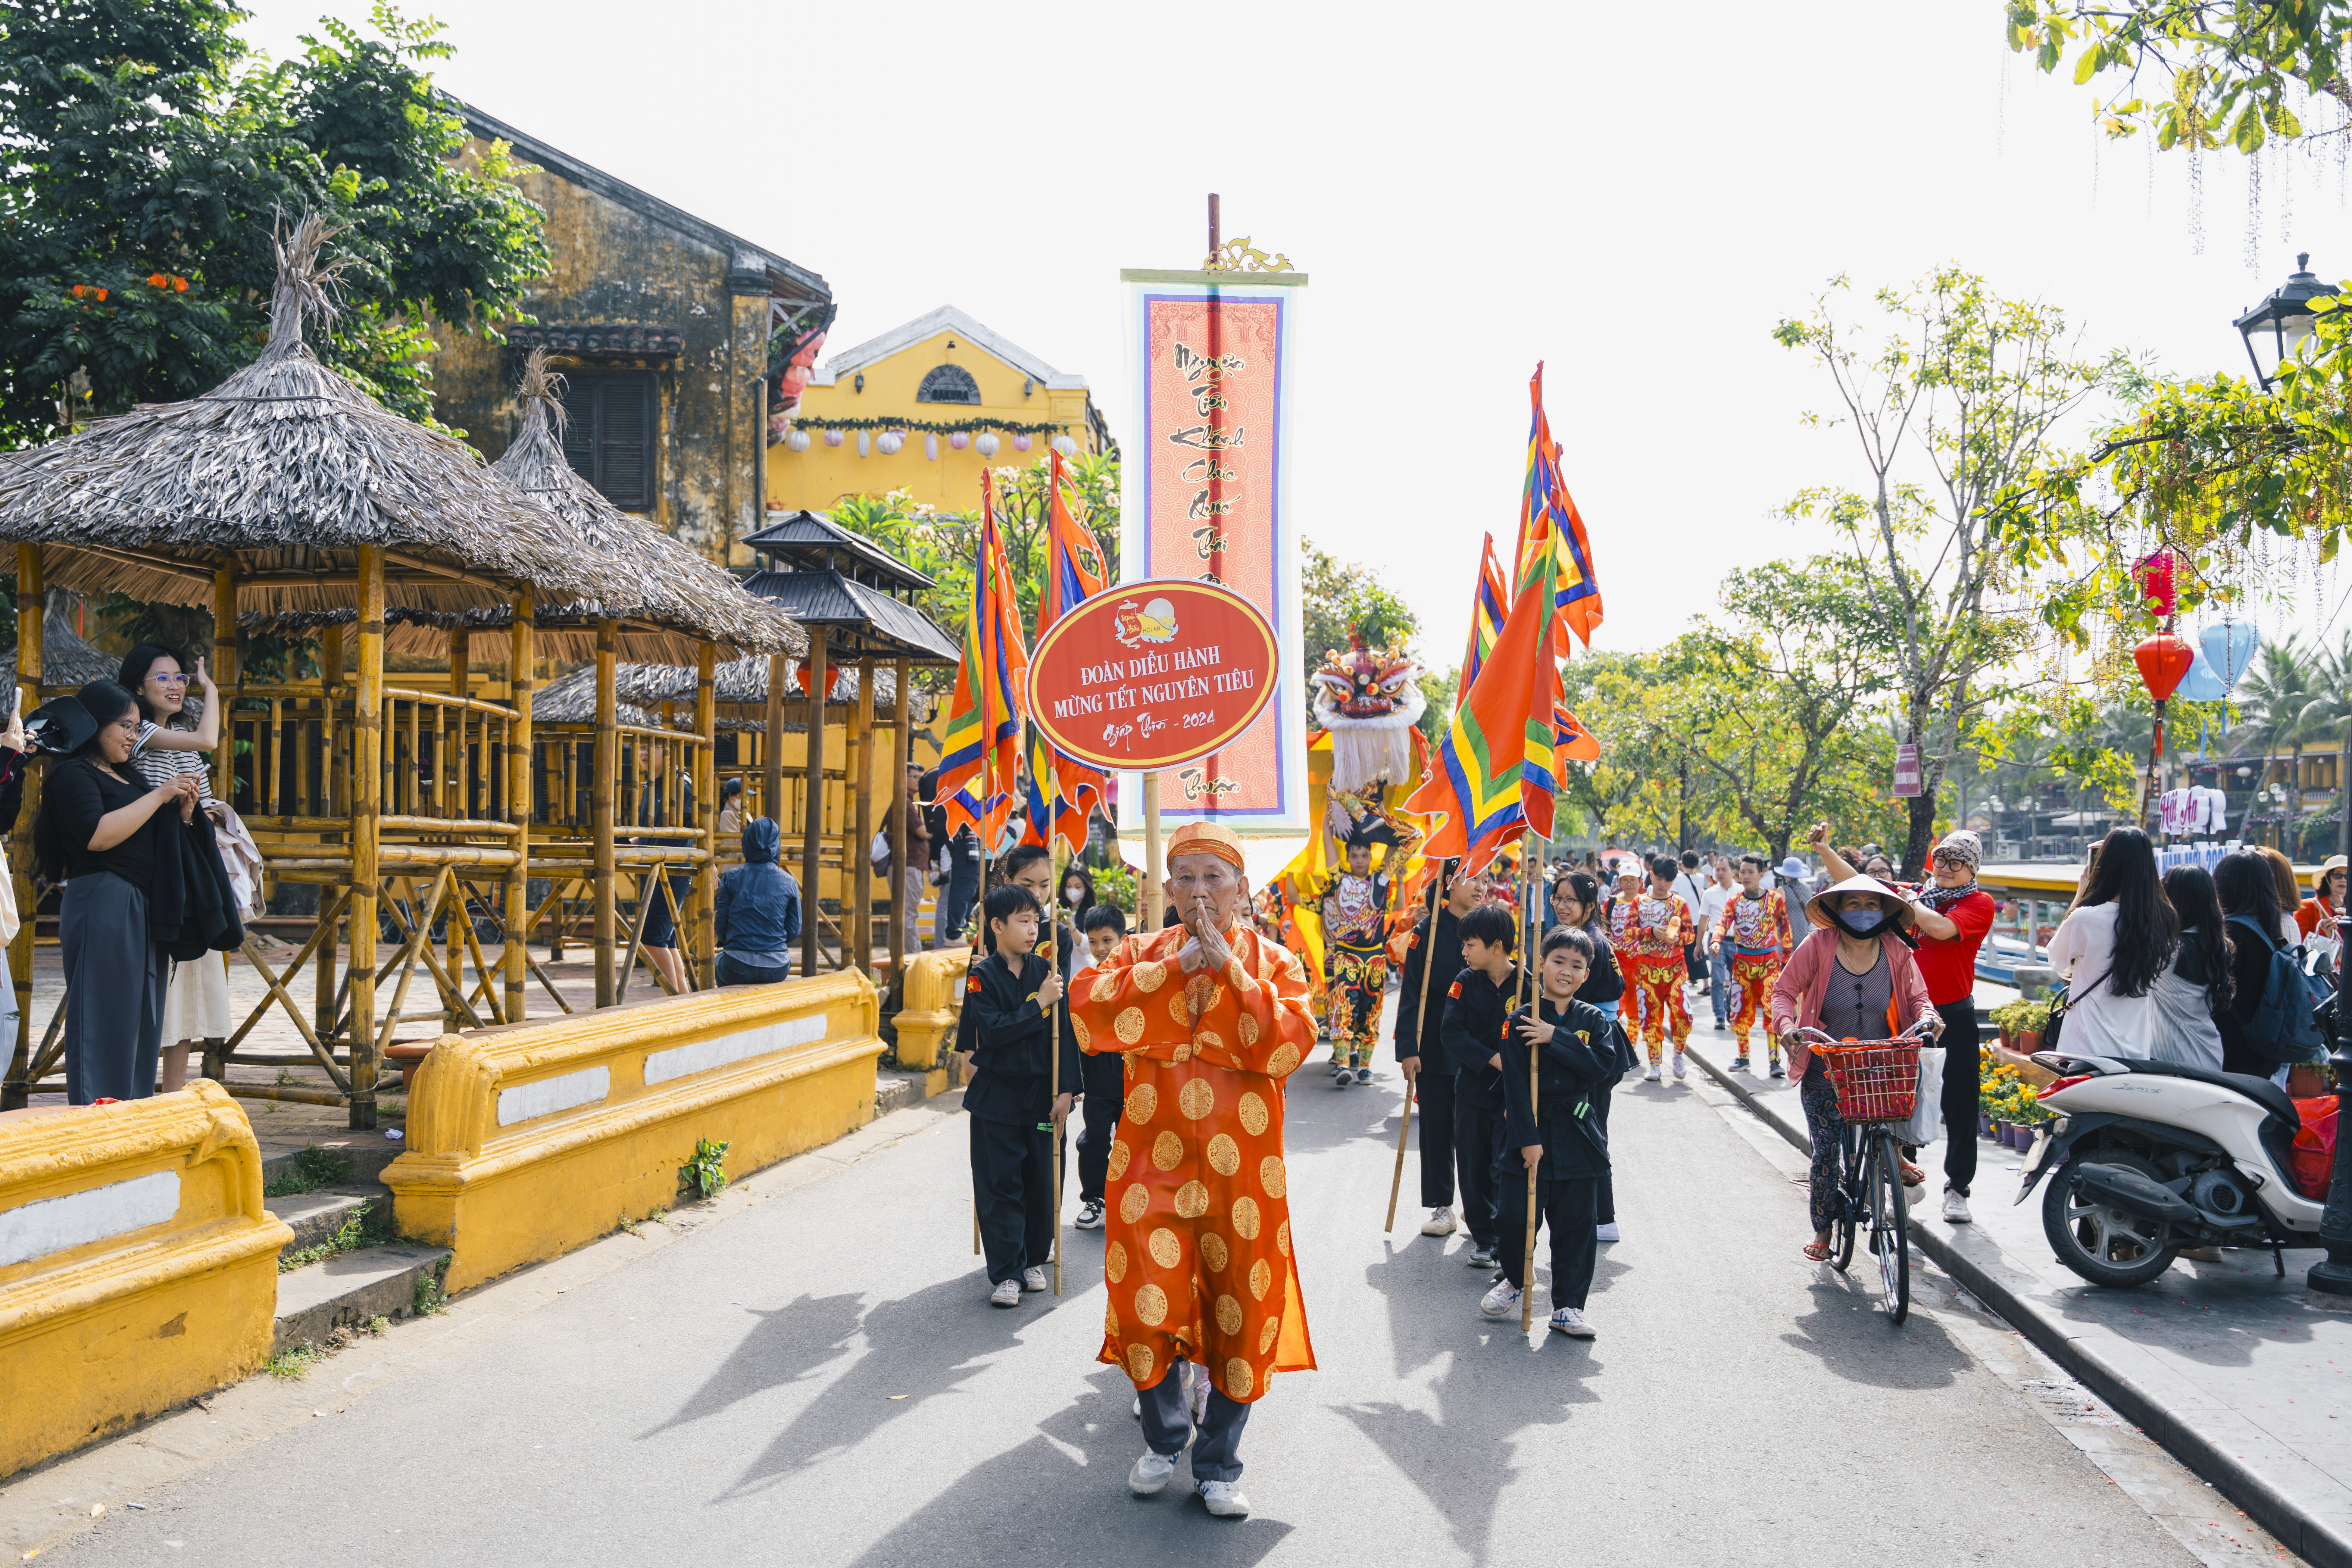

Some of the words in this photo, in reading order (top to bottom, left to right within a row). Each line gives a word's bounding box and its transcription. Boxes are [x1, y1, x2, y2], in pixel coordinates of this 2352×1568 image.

[1174, 343, 1244, 381] Nguyên
[932, 389, 969, 401] SAKURA
[1191, 384, 1227, 418] Tiêu
[1170, 425, 1244, 450] Khánh
[1182, 459, 1237, 482] Chúc
[1189, 489, 1242, 520] Quốc
[1192, 526, 1228, 560] Thái
[1080, 660, 1124, 686] ĐOÀN
[1130, 650, 1169, 678] DIỄU
[1174, 645, 1221, 671] HÀNH
[1053, 693, 1102, 719] MỪNG
[1106, 684, 1137, 710] TẾT
[1142, 675, 1210, 705] NGUYÊN
[1214, 669, 1254, 694] TIÊU
[1183, 709, 1215, 729] 2024
[1179, 767, 1241, 801] Thuận
[2160, 791, 2177, 831] Hội
[2180, 791, 2198, 825] An
[2206, 848, 2227, 873] 202
